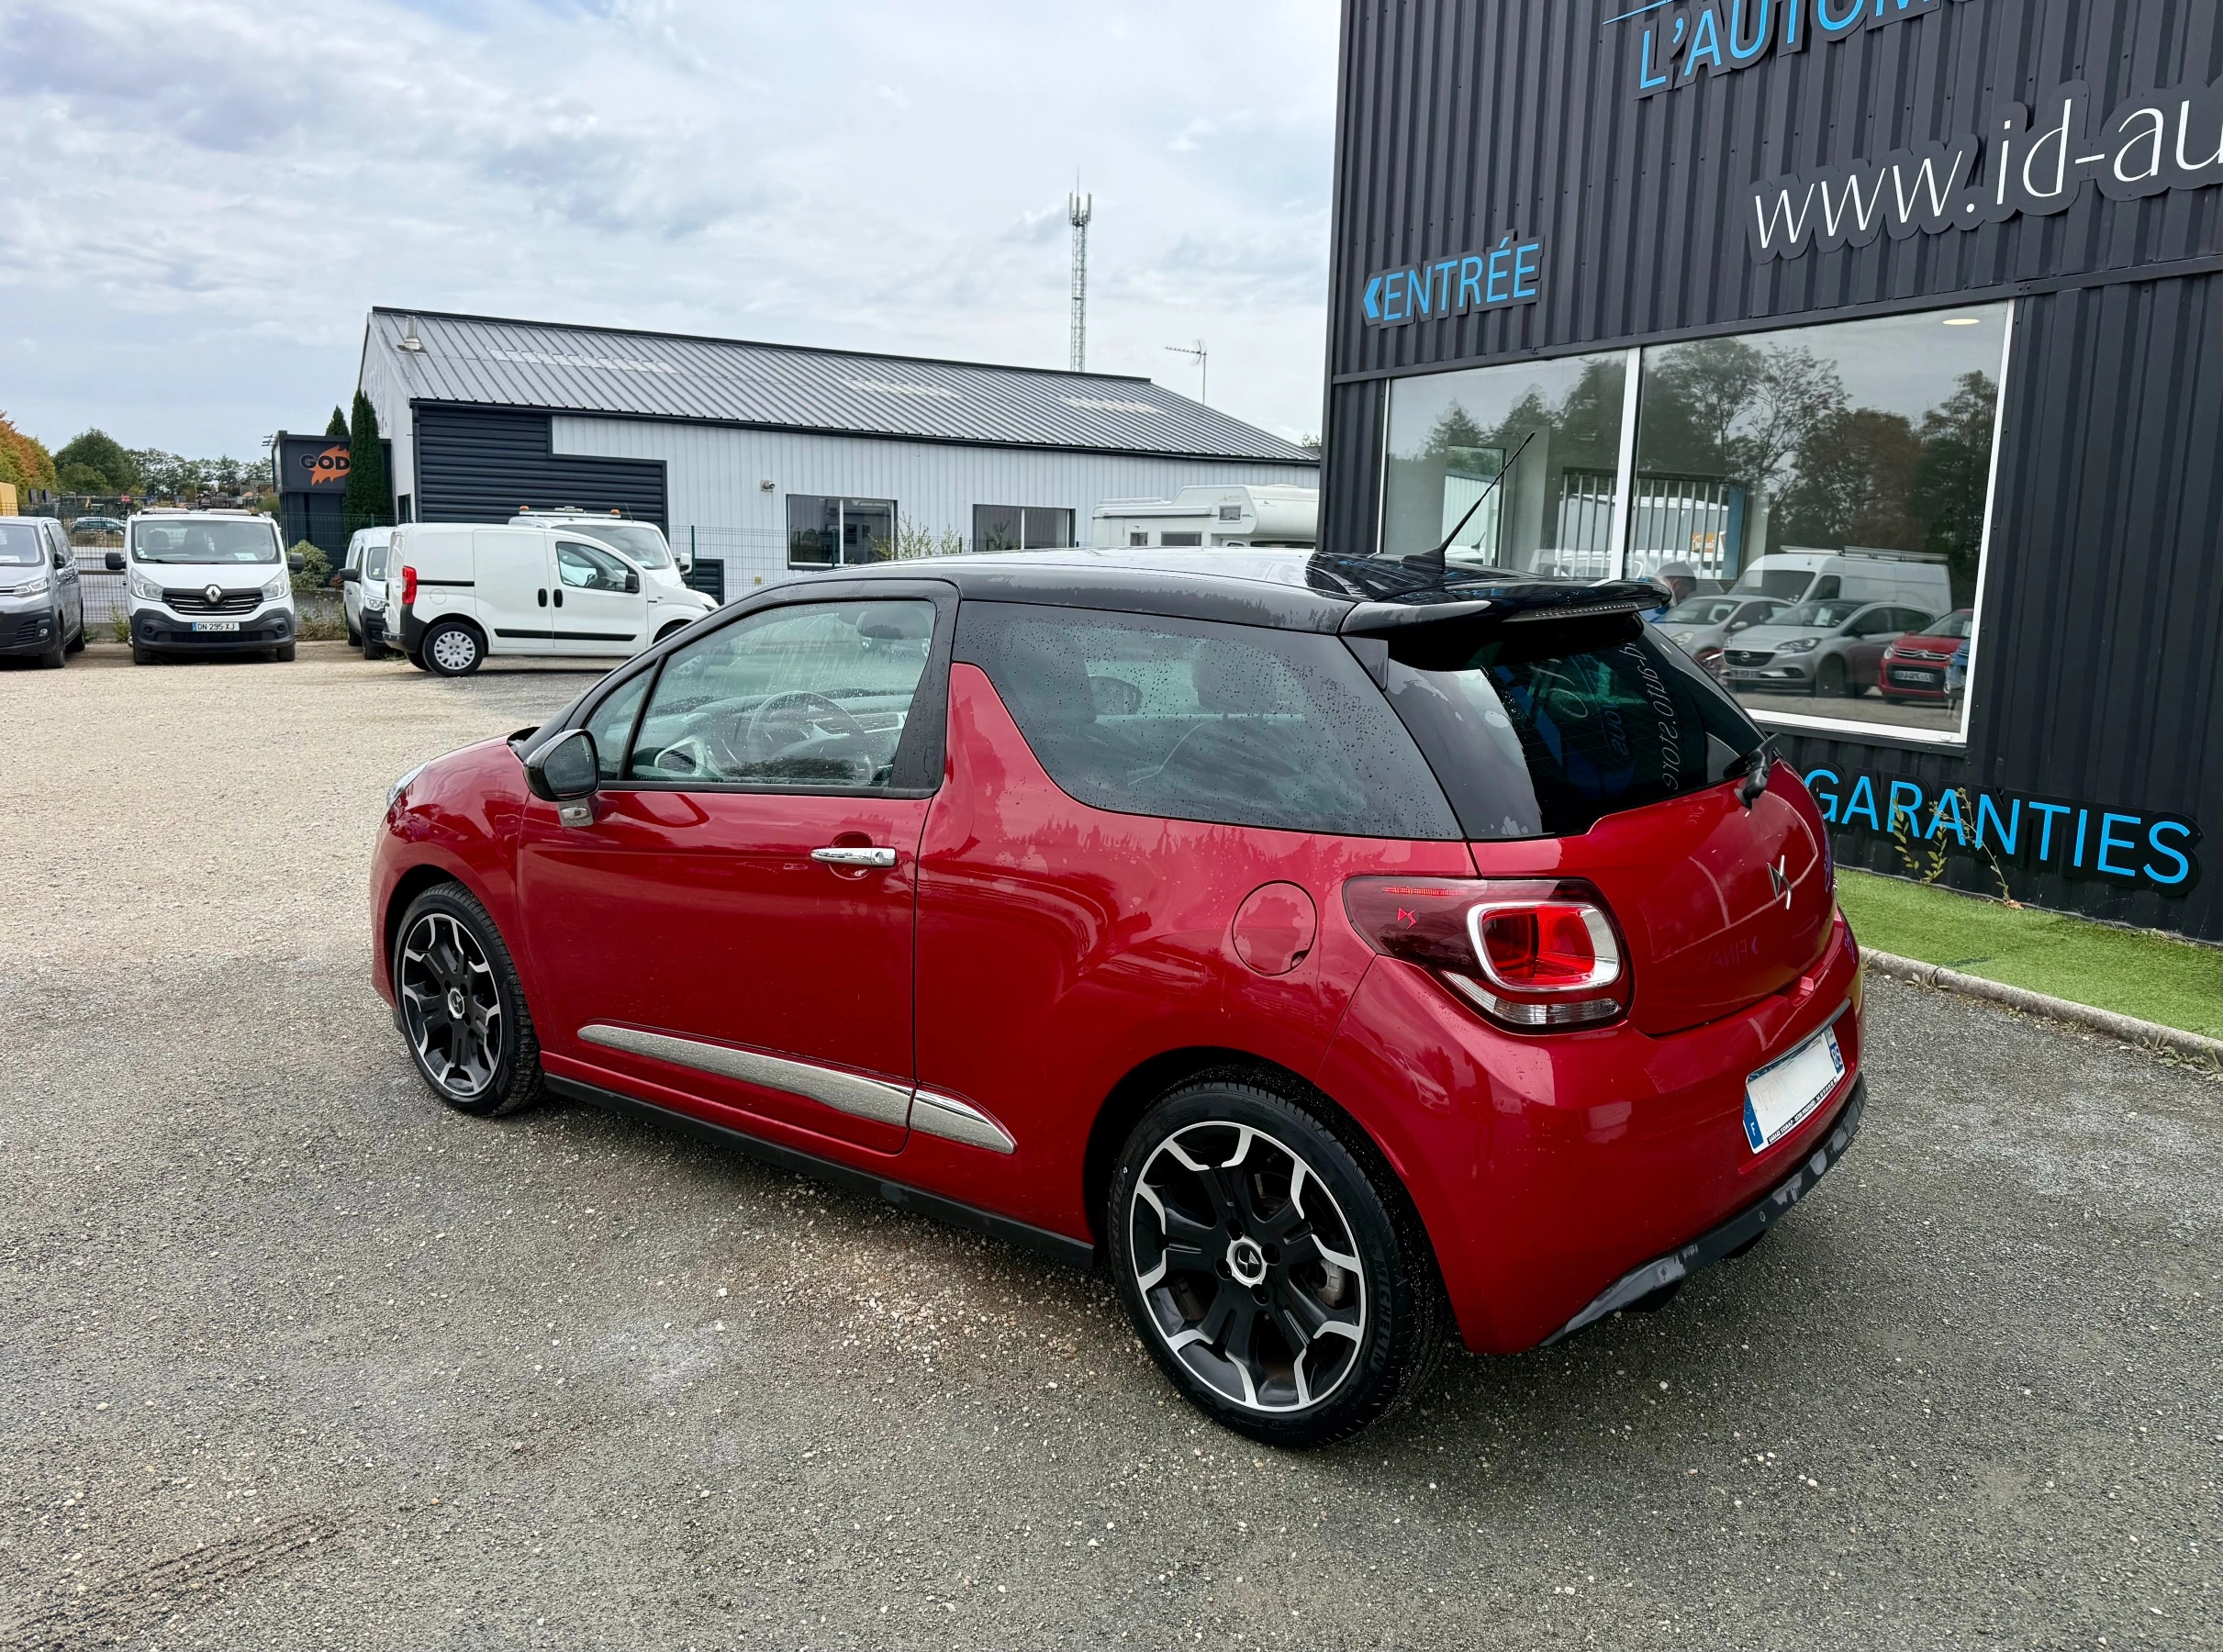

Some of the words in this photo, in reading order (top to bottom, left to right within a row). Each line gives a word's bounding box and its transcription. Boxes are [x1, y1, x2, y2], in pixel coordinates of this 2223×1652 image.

[1383, 236, 1539, 320] ENTRÉE
[1803, 768, 2191, 884] GARANTIES
[1372, 1258, 1391, 1367] MICHELIN
